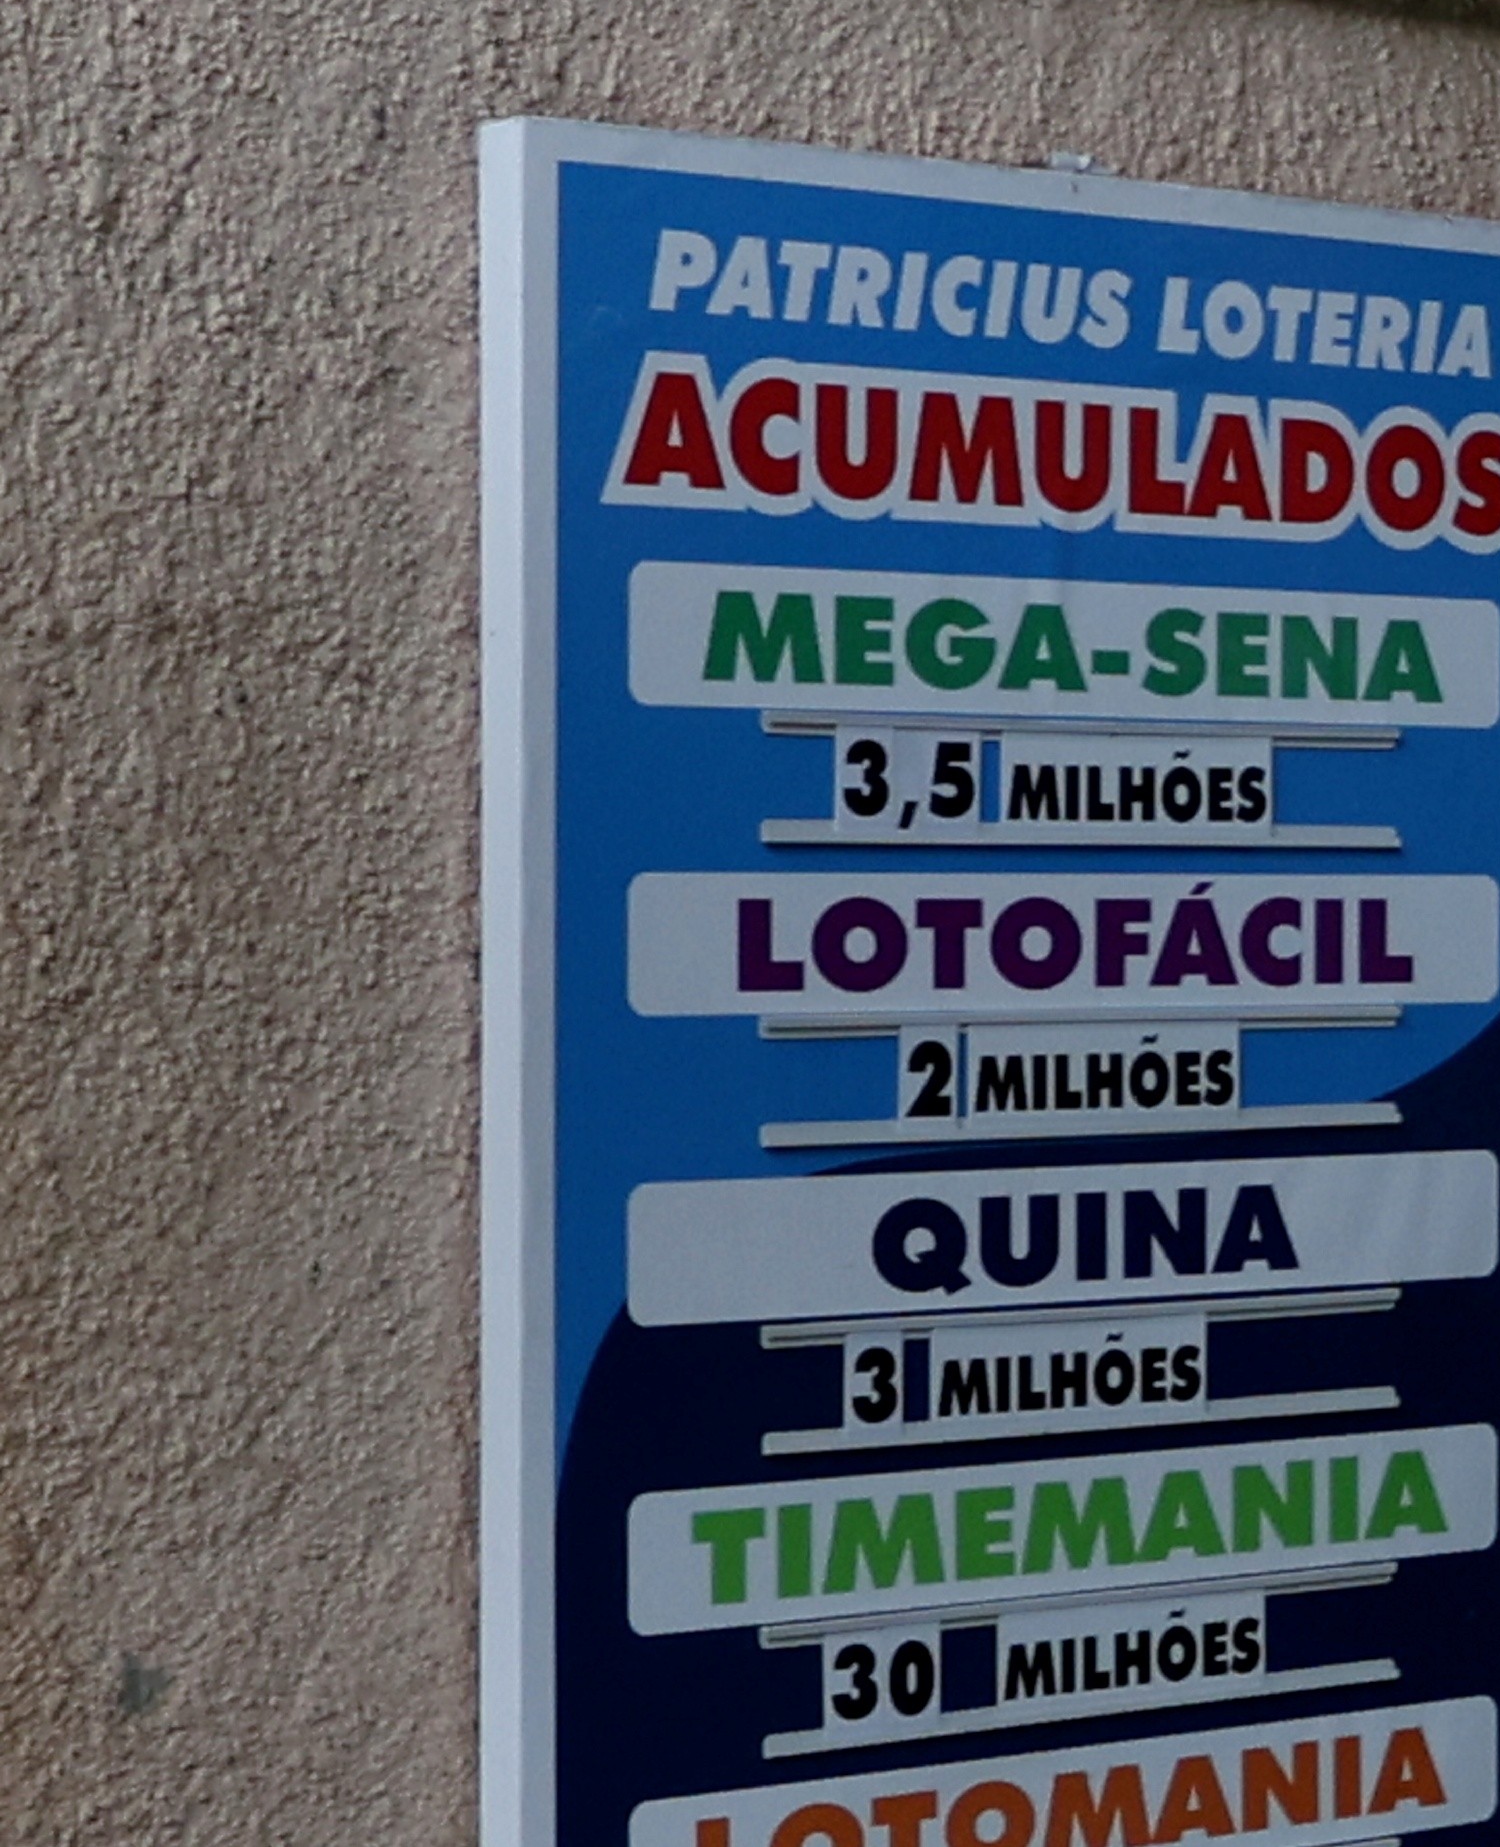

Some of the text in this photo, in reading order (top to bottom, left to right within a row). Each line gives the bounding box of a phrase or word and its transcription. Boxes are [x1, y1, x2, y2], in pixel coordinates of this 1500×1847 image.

[649, 229, 1493, 378] PATRICIUS LOTERIA
[703, 590, 1443, 703] MEGA-SENA
[842, 740, 1267, 830] 3,5 MILHÕES
[735, 880, 1414, 992] LOTOFÁCIL
[906, 1033, 1235, 1118] 2 MILHÕES
[872, 1184, 1299, 1296] QUINA
[852, 1333, 1201, 1425] 3 MILHÕES
[691, 1449, 1448, 1605] TIMEMANIA
[831, 1609, 1261, 1718] 30 MILHÕES
